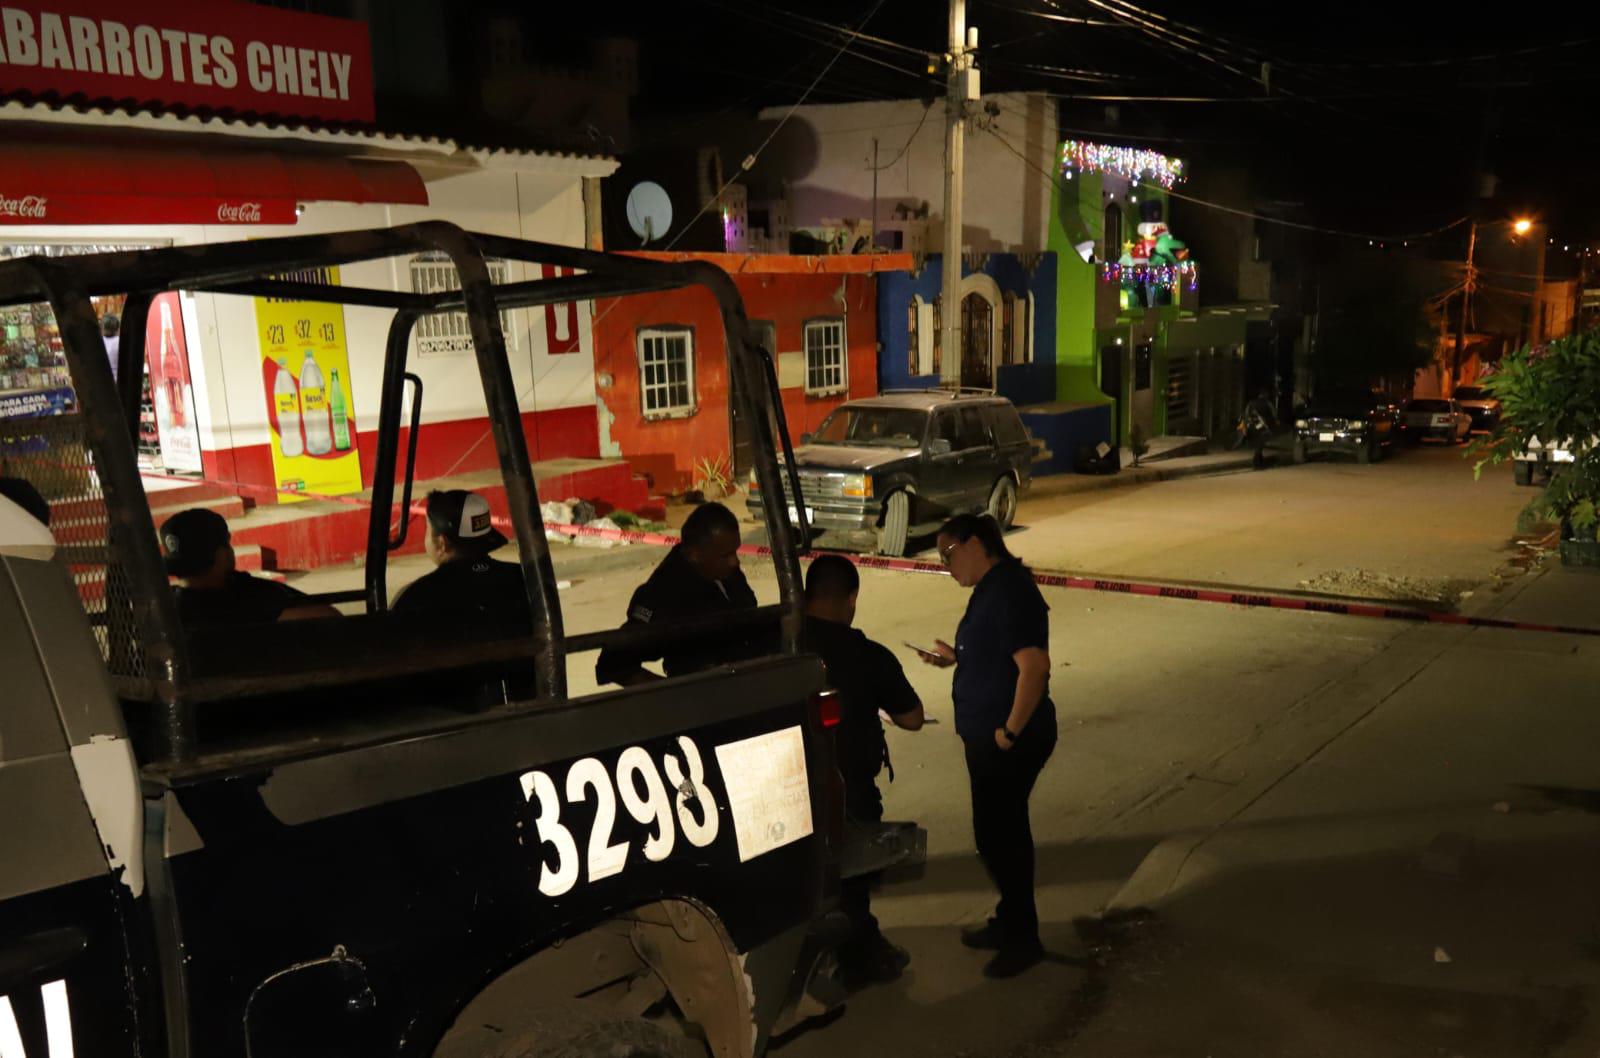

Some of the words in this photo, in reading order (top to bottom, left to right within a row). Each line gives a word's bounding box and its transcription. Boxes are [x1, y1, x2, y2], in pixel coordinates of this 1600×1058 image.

[0, 8, 238, 88] BARROTES
[246, 41, 351, 100] CHELY
[0, 194, 47, 218] oca-Cola
[519, 735, 719, 896] 3298
